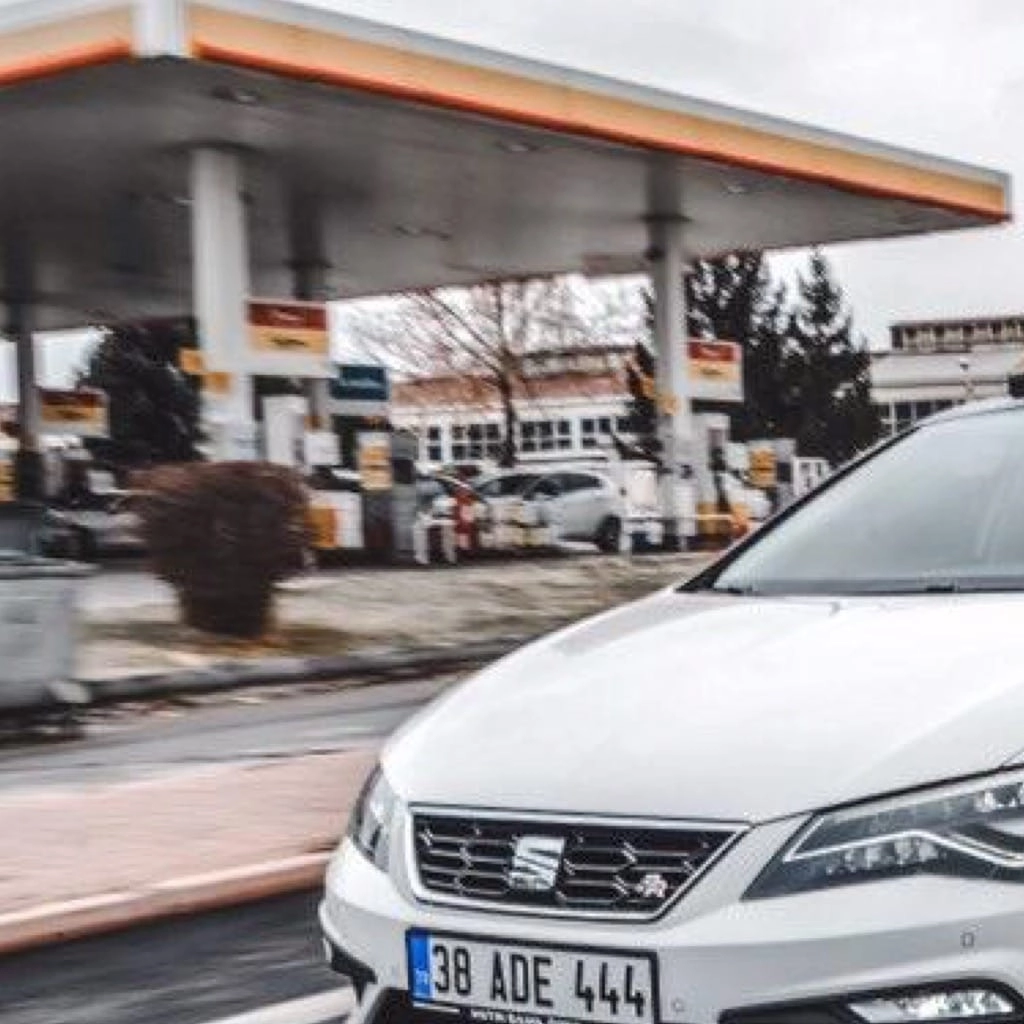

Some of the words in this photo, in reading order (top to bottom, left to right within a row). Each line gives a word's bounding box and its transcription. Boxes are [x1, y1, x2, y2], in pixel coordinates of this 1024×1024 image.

[433, 945, 471, 996] 38
[490, 952, 553, 1007] ADE
[575, 960, 644, 1017] 444
